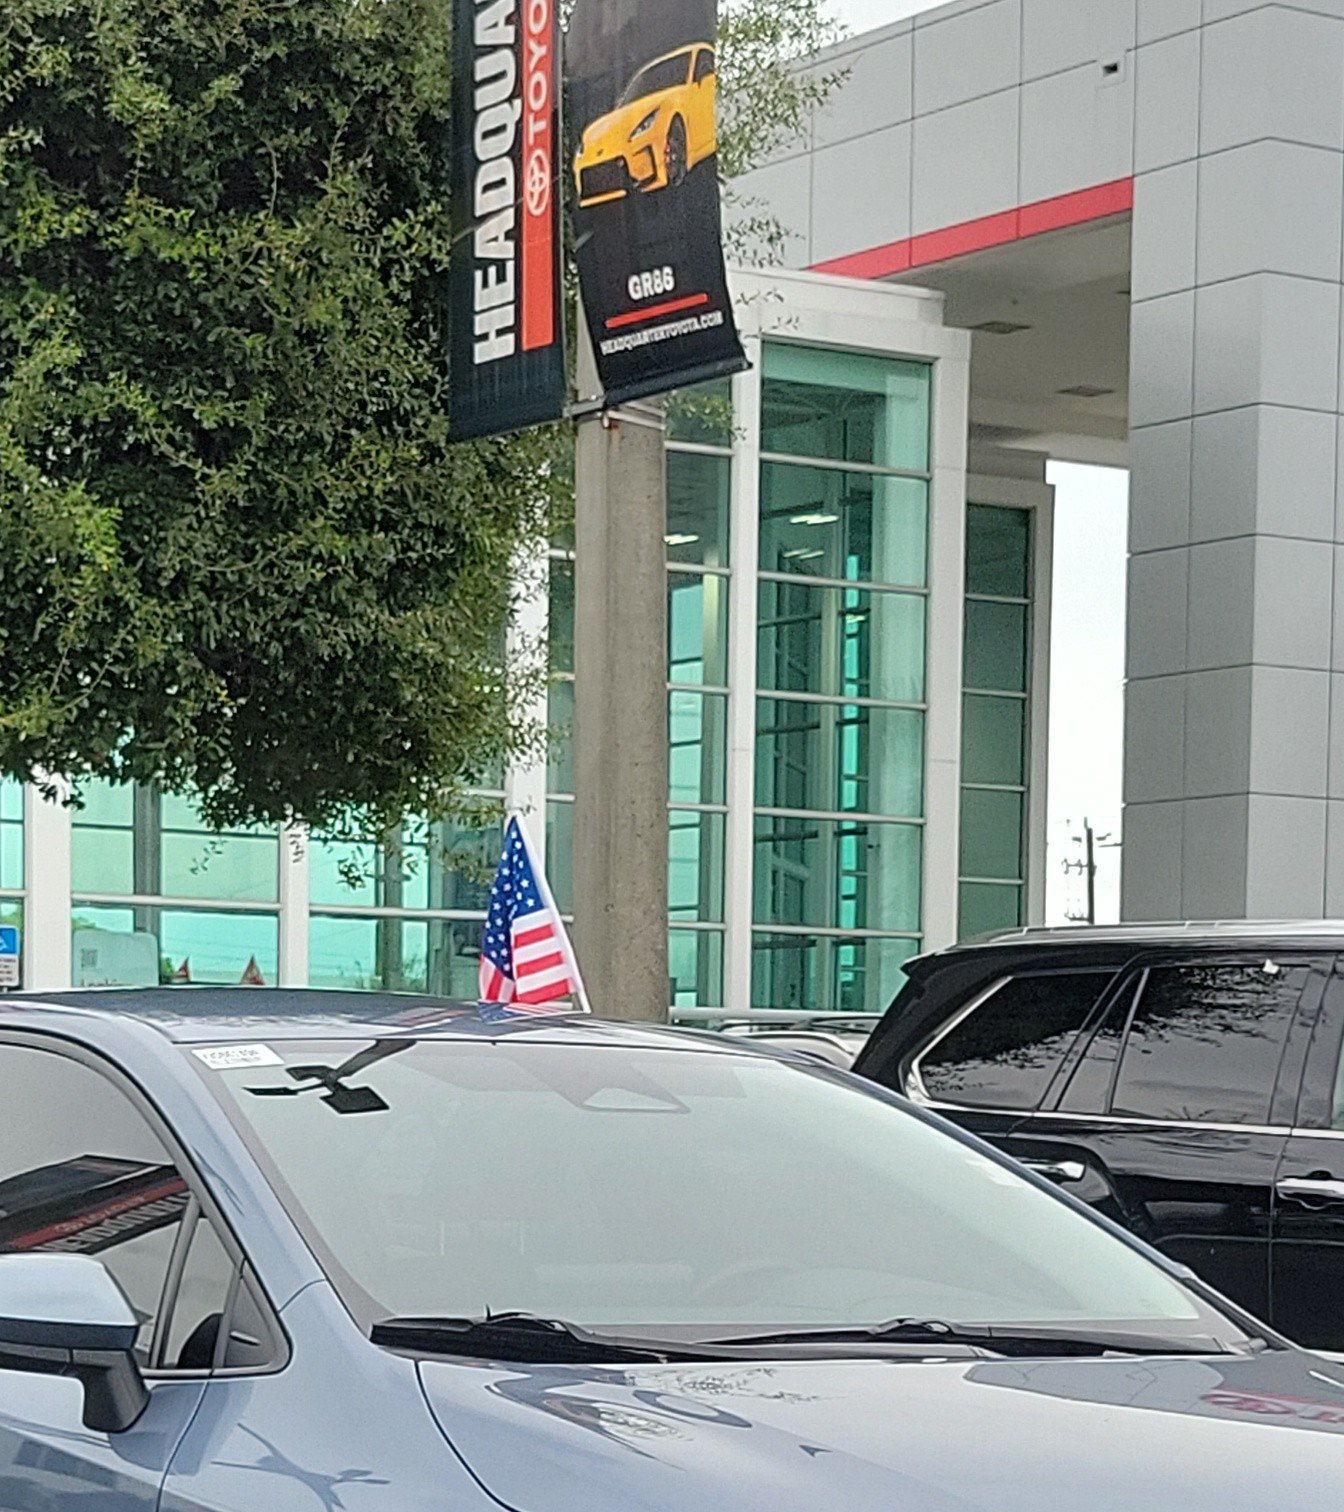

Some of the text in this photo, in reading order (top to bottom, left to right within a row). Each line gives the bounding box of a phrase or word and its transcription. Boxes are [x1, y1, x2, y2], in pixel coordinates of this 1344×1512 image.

[473, 0, 522, 365] HEADQUA
[627, 265, 676, 301] GR86
[599, 310, 724, 356] HEADQUARTERTOYOTA.COM
